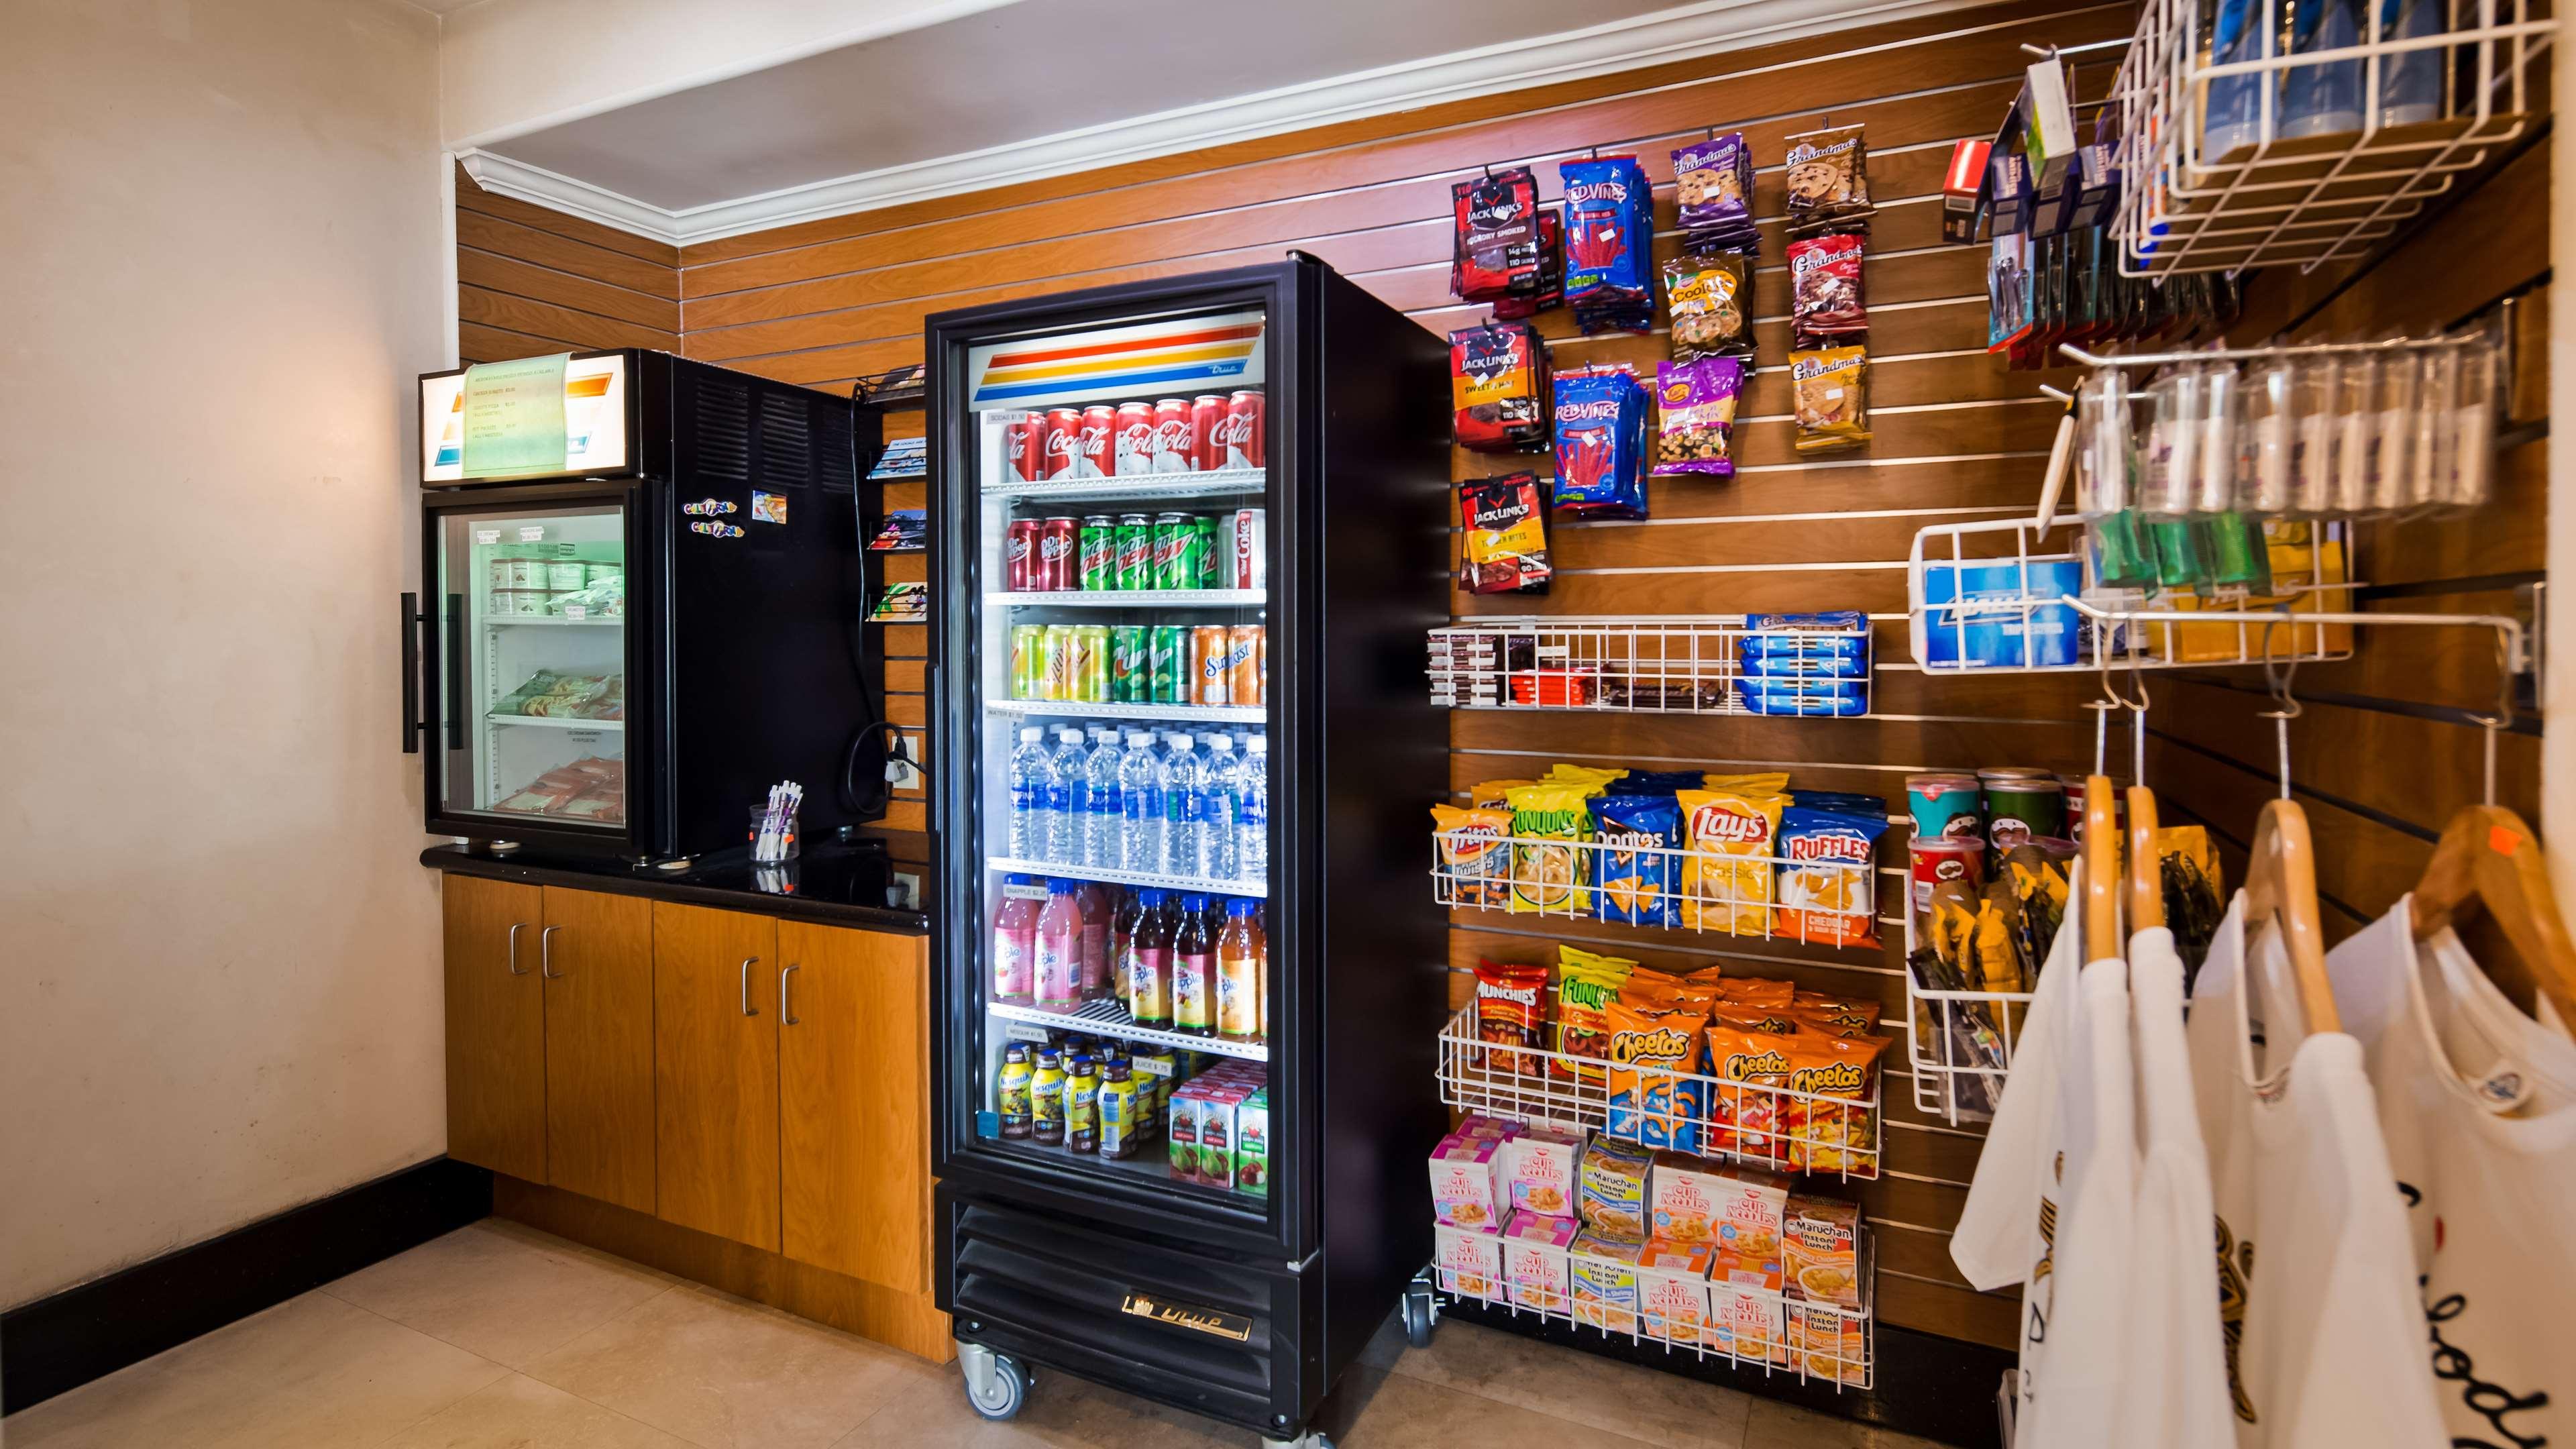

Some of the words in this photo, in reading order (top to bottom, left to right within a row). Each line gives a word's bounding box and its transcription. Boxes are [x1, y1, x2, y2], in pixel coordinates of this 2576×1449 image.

[1466, 209, 1491, 223] JACK
[1461, 359, 1487, 372] JACK
[1474, 511, 1499, 525] JACK
[1595, 830, 1664, 849] Doritos
[1792, 837, 1870, 863] RUFFLES
[1478, 981, 1537, 1006] MUNCHIES
[1613, 1029, 1689, 1063] Cheetos
[1792, 1064, 1864, 1102] Cheetos
[1594, 1171, 1638, 1191] Maruchan
[1597, 1181, 1627, 1195] Instant
[1600, 1188, 1623, 1199] Lunch
[1796, 1220, 1850, 1240] Maruchan
[1801, 1232, 1837, 1245] Instant
[1805, 1241, 1833, 1252] Lunch
